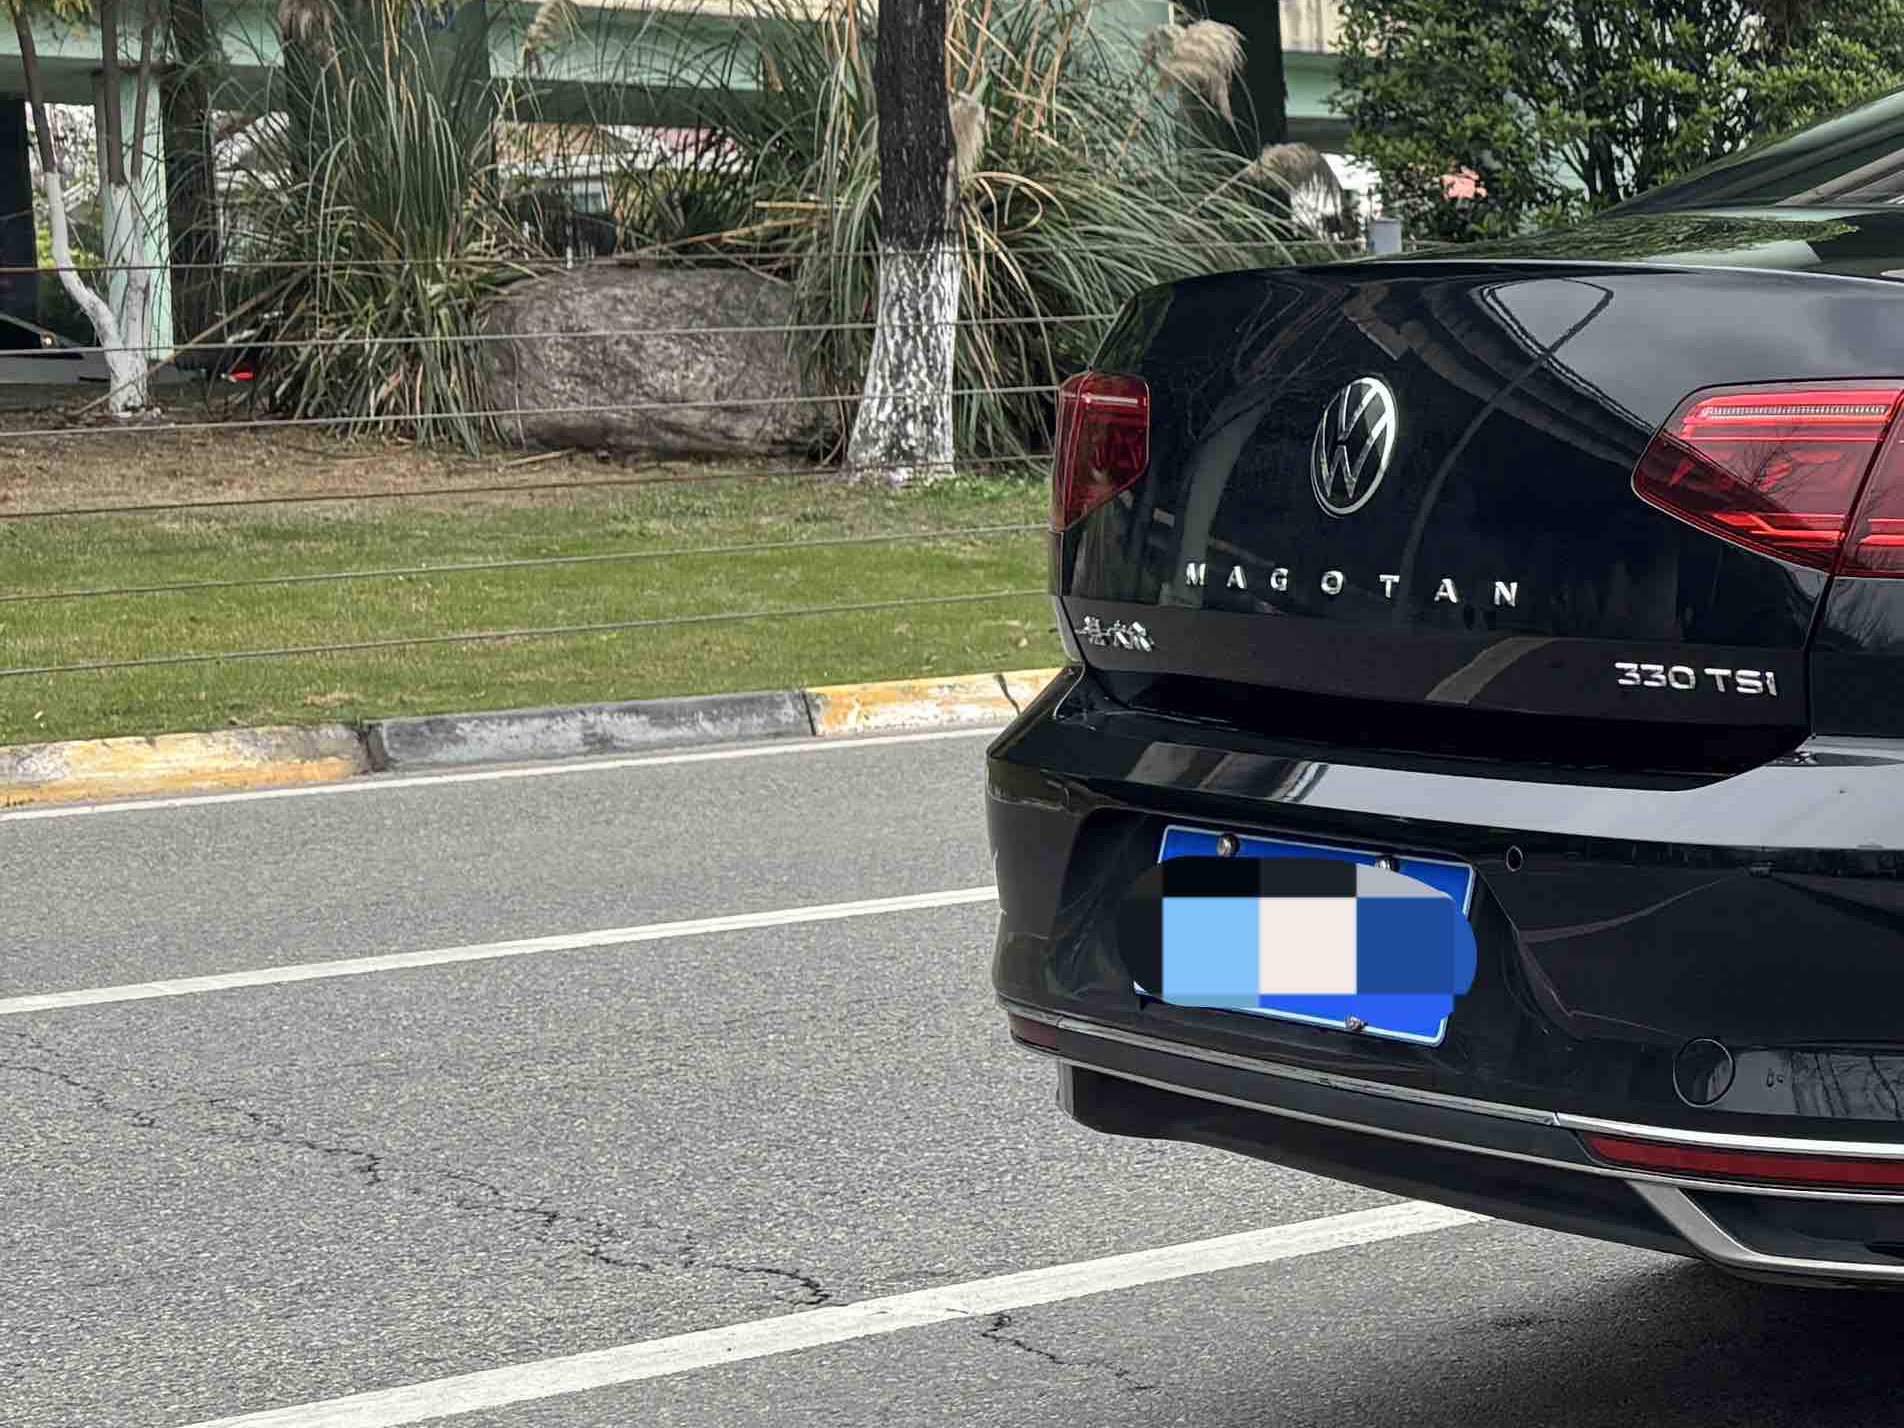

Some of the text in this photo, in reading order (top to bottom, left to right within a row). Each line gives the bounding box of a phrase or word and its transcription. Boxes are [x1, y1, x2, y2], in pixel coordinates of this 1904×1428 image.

[1184, 561, 1519, 607] MAGOTAN
[1614, 662, 1778, 697] 330 TSI
